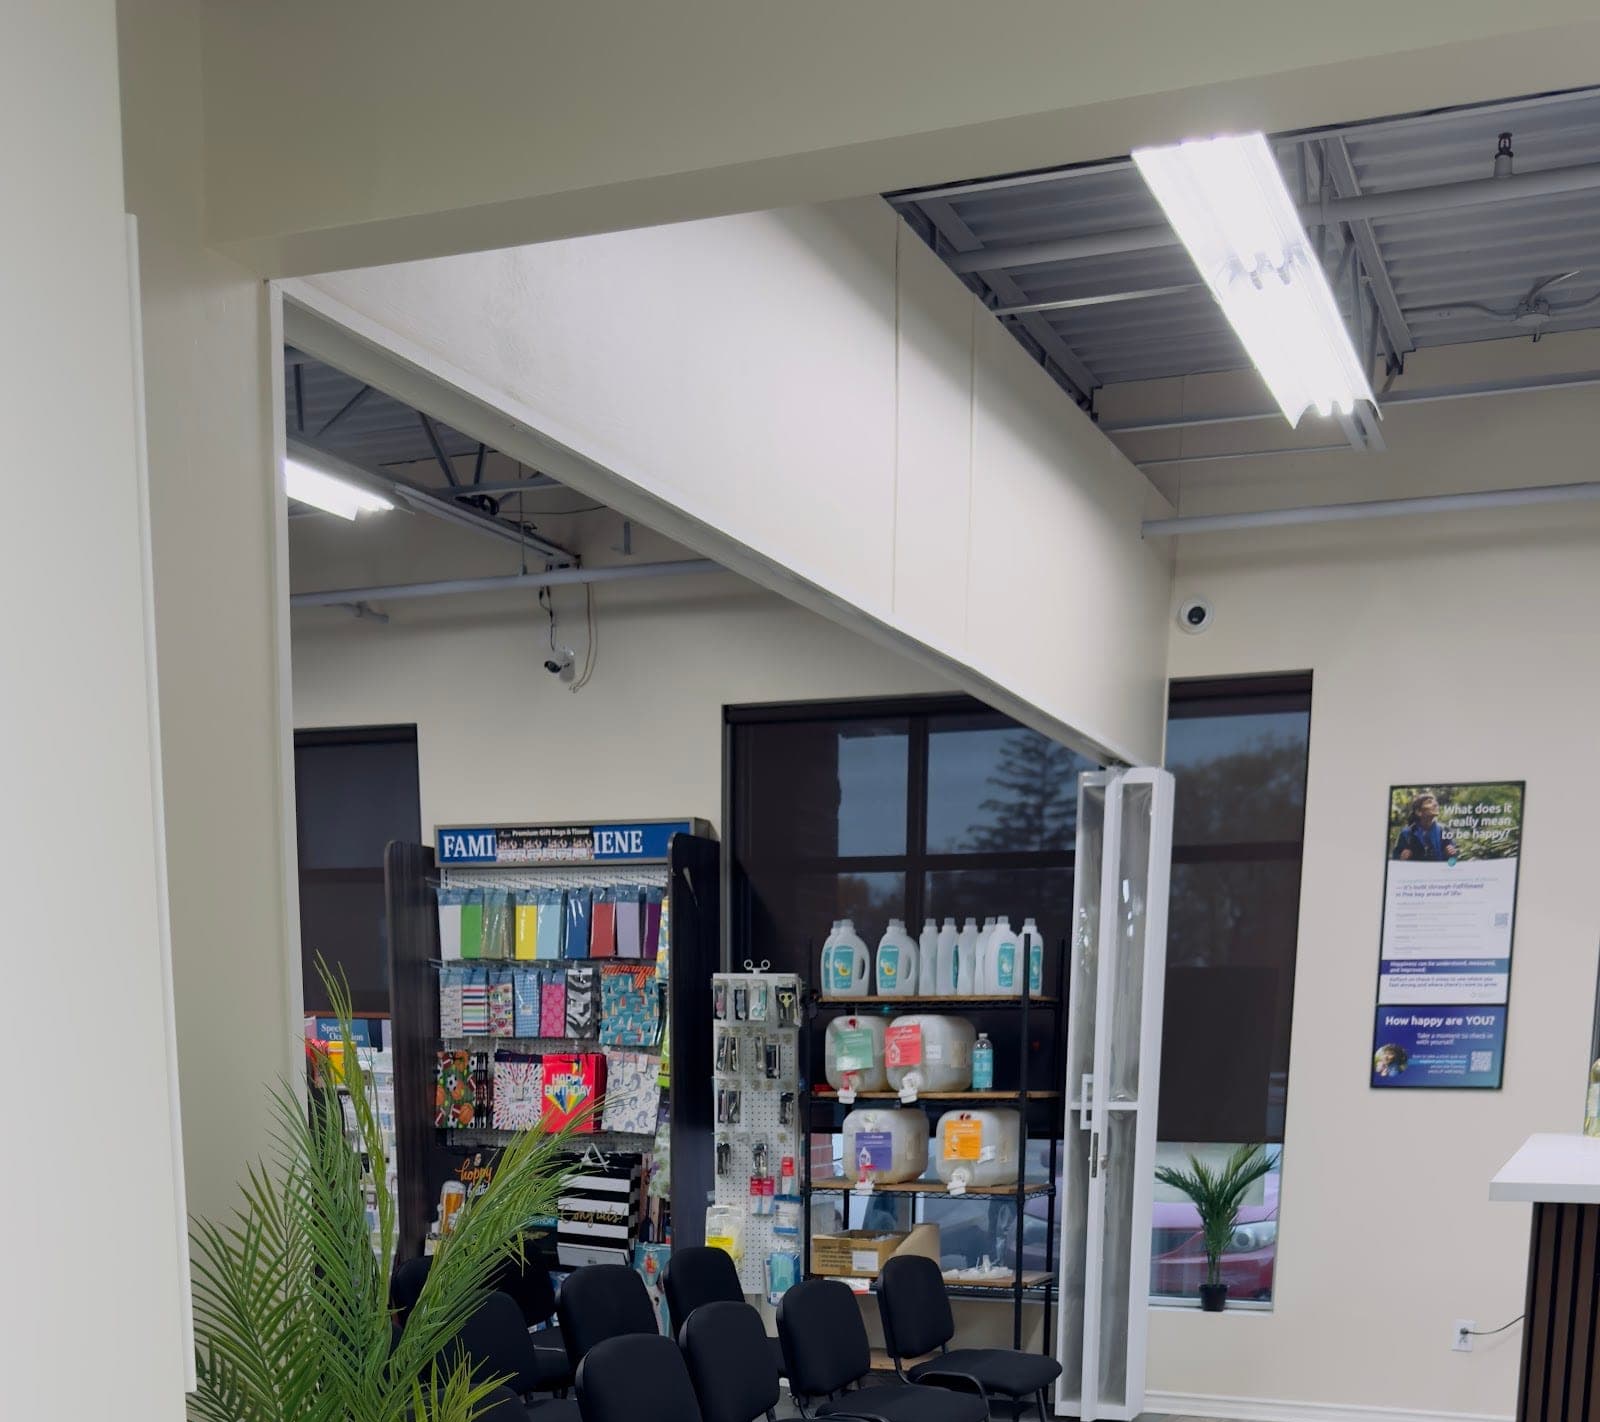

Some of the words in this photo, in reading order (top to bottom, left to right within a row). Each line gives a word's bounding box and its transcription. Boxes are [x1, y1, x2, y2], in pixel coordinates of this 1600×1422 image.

[1443, 803, 1472, 814] What
[1475, 802, 1501, 814] does
[1504, 802, 1512, 813] it
[1448, 816, 1479, 828] really
[1481, 817, 1511, 826] mean
[512, 829, 538, 837] Premium
[539, 828, 551, 836] Gift
[552, 828, 566, 837] Bags
[1441, 830, 1454, 840] to
[1455, 830, 1470, 839] be
[1472, 829, 1511, 841] happy?
[443, 834, 497, 858] FAMI
[1385, 1016, 1409, 1026] How
[1411, 1015, 1444, 1028] happy
[1445, 1017, 1462, 1025] are
[1465, 1016, 1495, 1025] YOU?
[321, 1023, 349, 1034] Specl
[551, 1073, 585, 1086] HAPPY
[544, 1084, 592, 1096] BIRTHDAY
[559, 1203, 627, 1228] Congrats!
